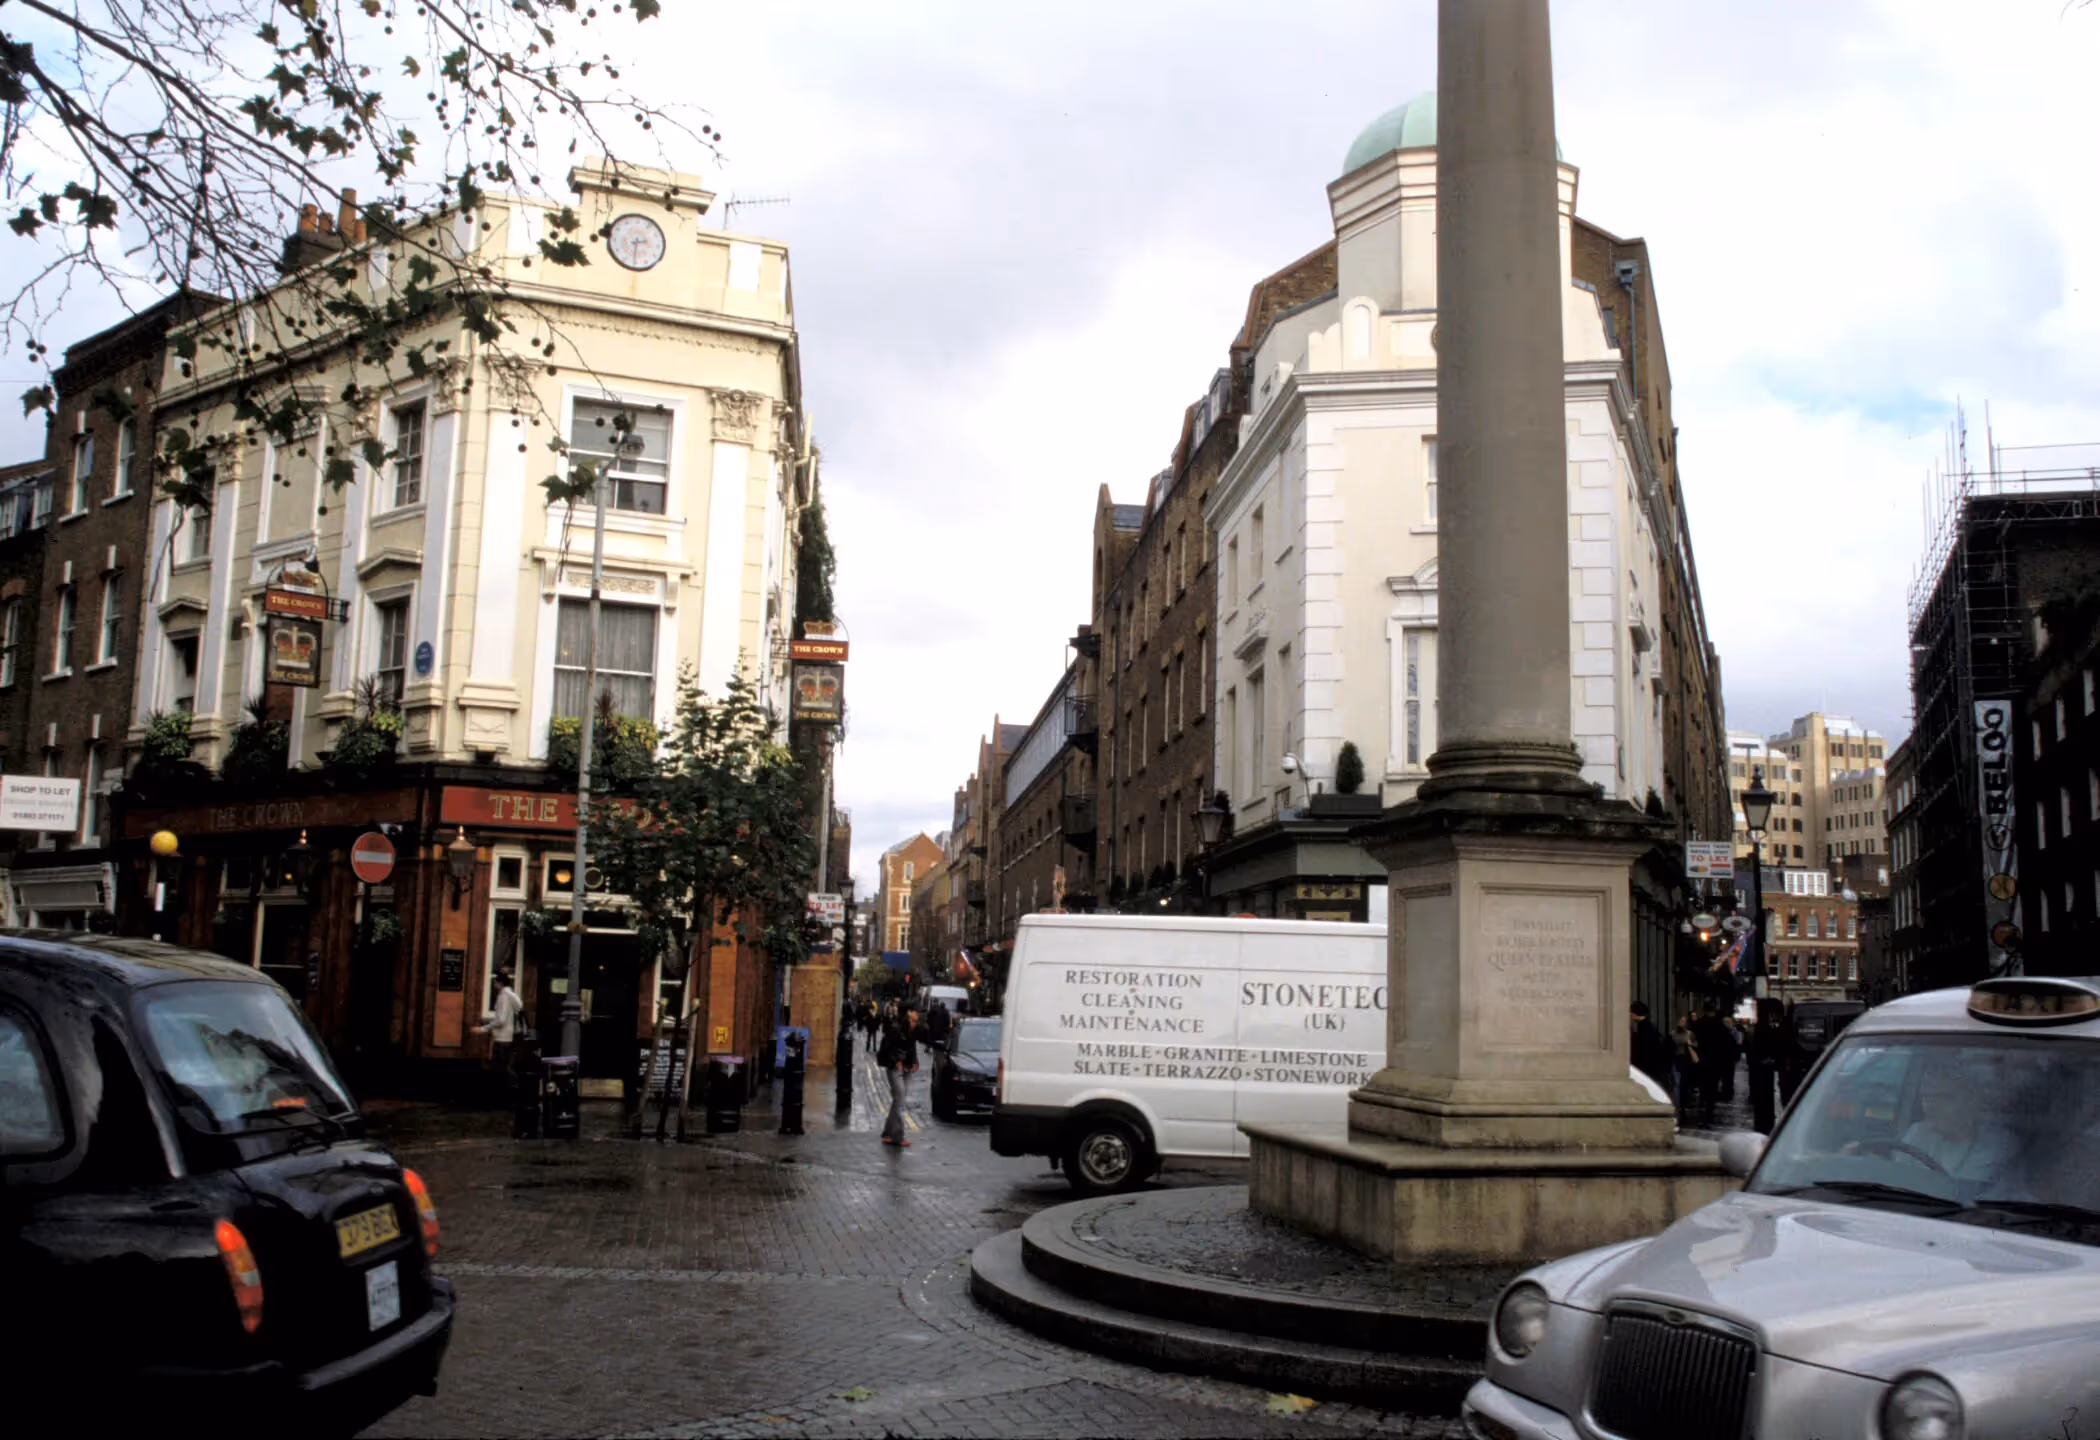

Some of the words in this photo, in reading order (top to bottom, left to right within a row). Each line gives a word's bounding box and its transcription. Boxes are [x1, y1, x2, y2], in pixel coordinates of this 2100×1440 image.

[812, 646, 843, 654] CROWN
[10, 785, 37, 794] SHOP
[53, 788, 71, 796] LET
[489, 793, 559, 823] THE
[1065, 970, 1203, 988] RESTORATION
[1081, 993, 1184, 1010] CLEANING
[1059, 1014, 1205, 1034] MAINTENANCE
[1303, 1013, 1346, 1032] (UK)
[1077, 1043, 1153, 1059] MARBLE
[1163, 1046, 1249, 1063] GRANITE
[1260, 1050, 1369, 1068] LIMESTONE
[1073, 1060, 1132, 1077] SLATE
[1143, 1063, 1242, 1081] TERRAZZO
